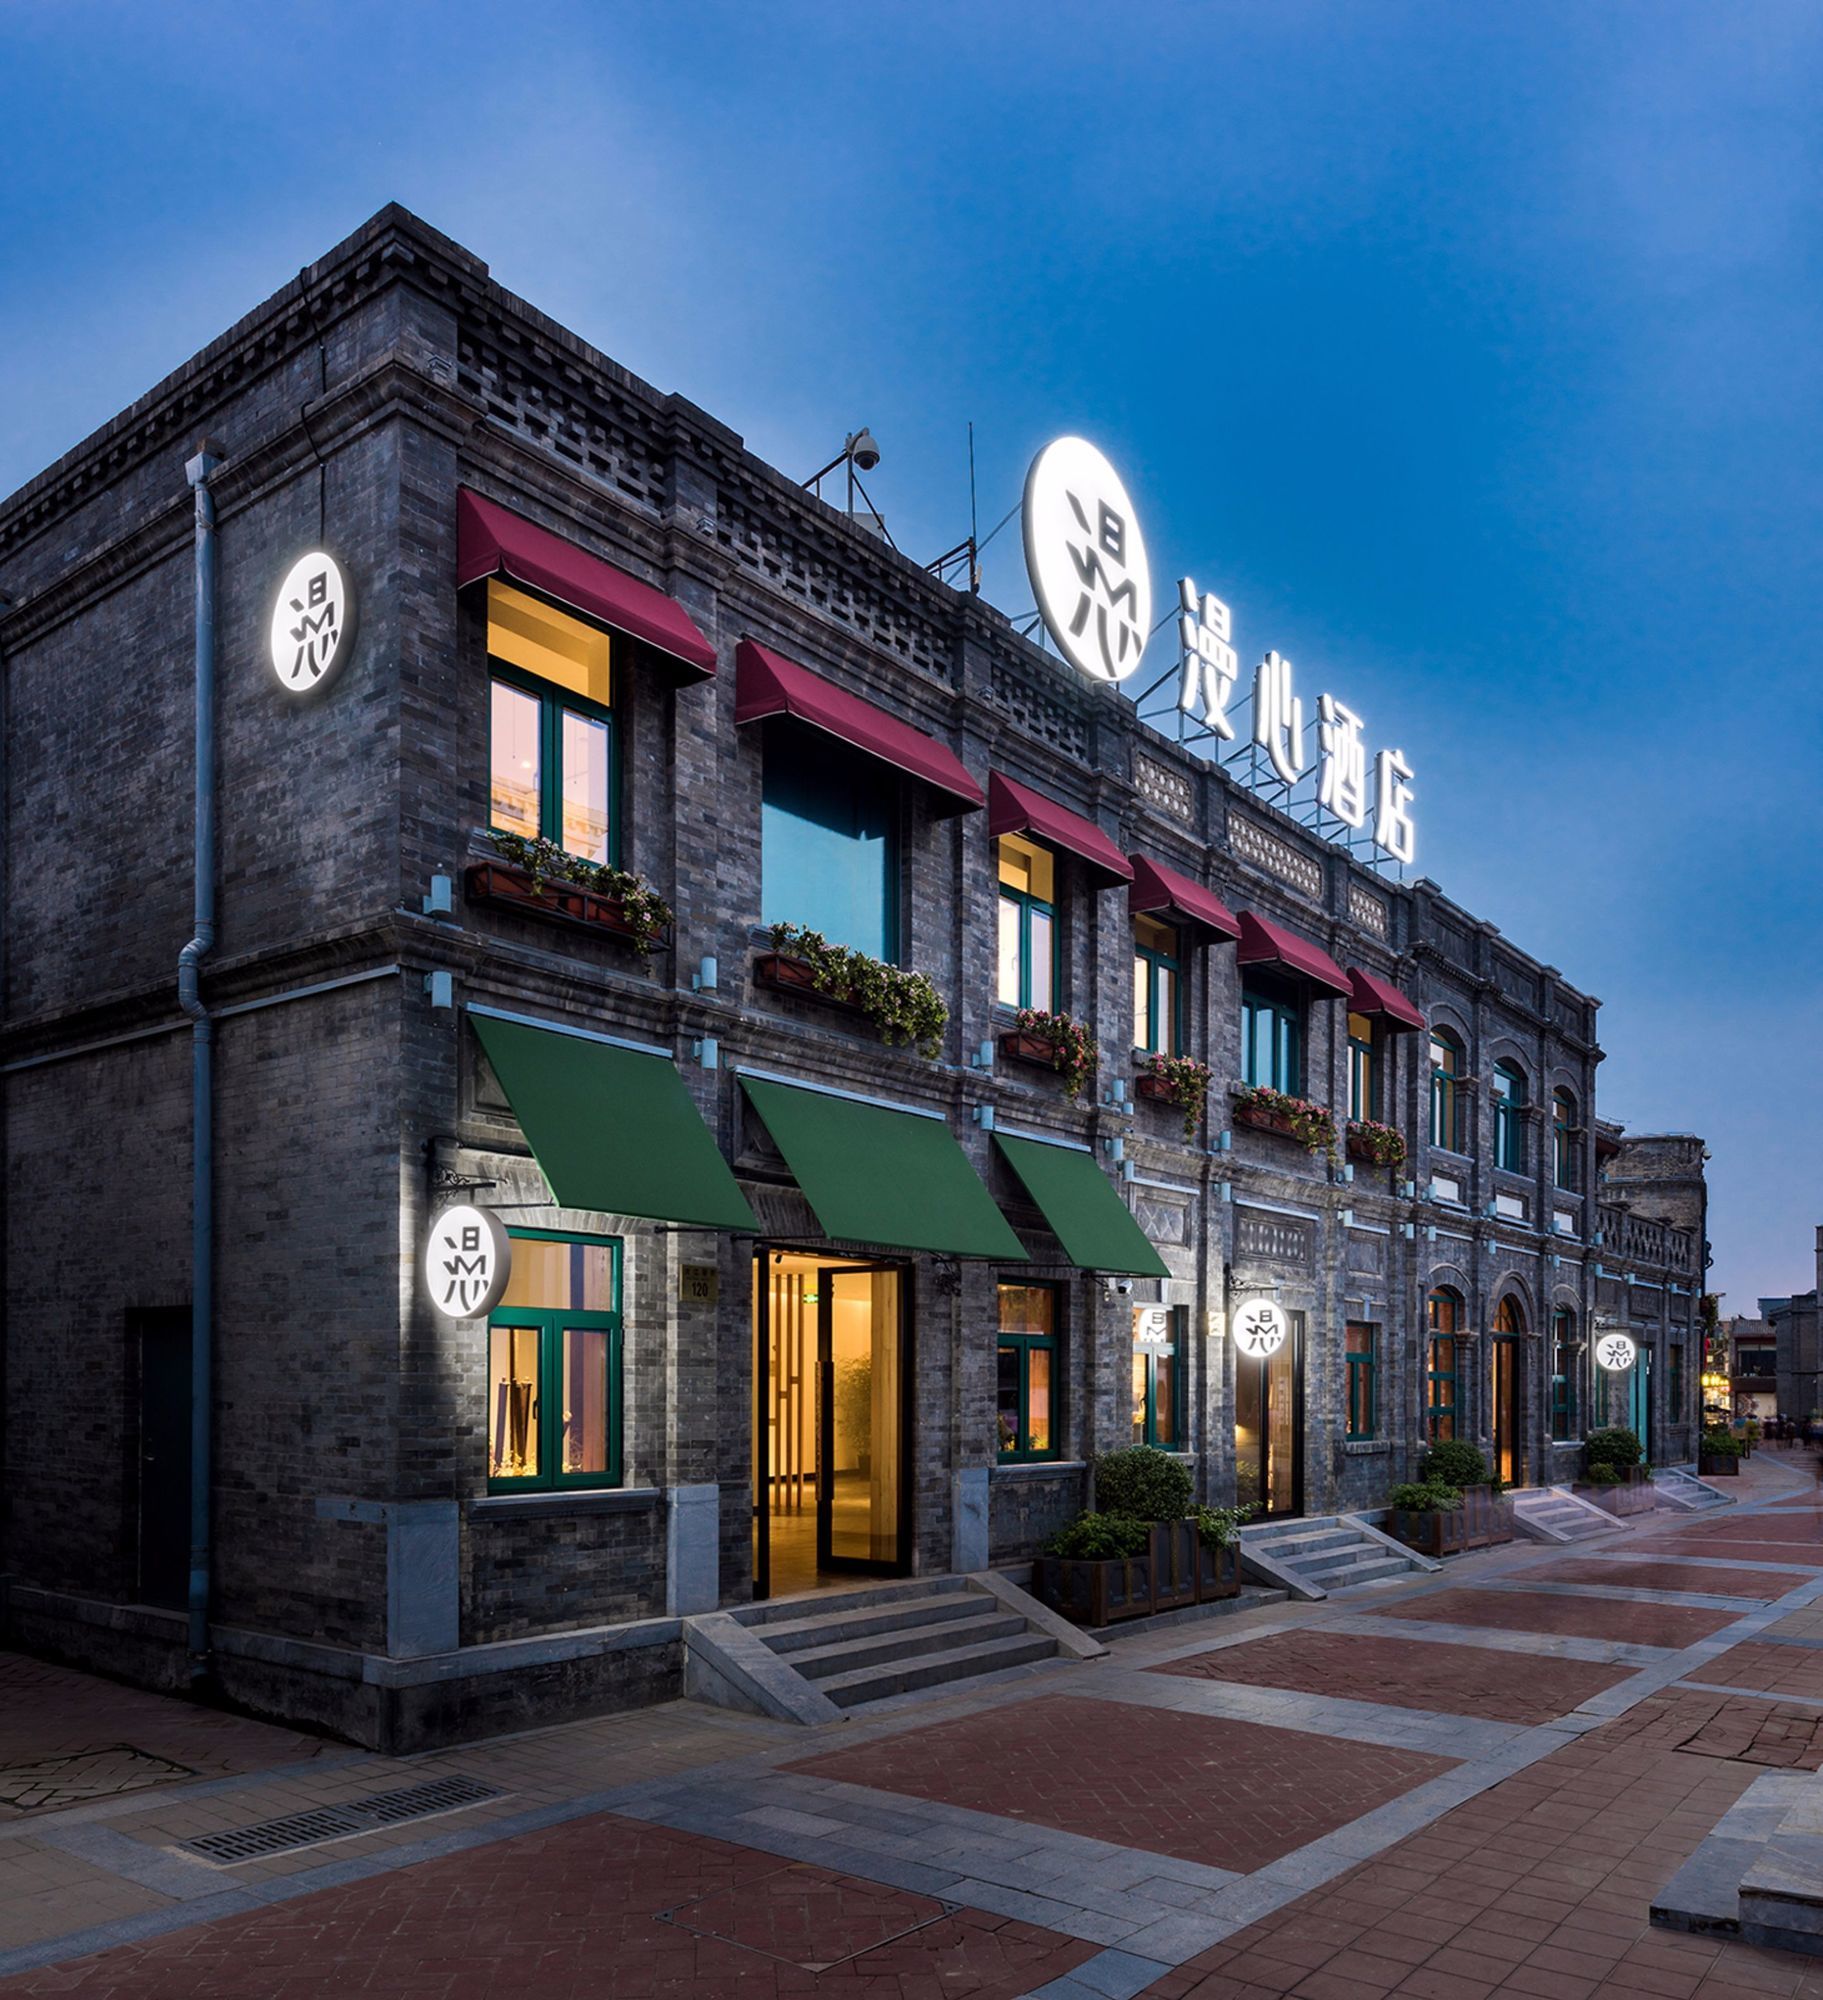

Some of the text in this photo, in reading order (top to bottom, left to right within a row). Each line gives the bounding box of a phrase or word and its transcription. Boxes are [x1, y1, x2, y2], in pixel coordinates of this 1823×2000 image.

[1177, 575, 1416, 866] 漫心酒店
[692, 1281, 709, 1297] 120
